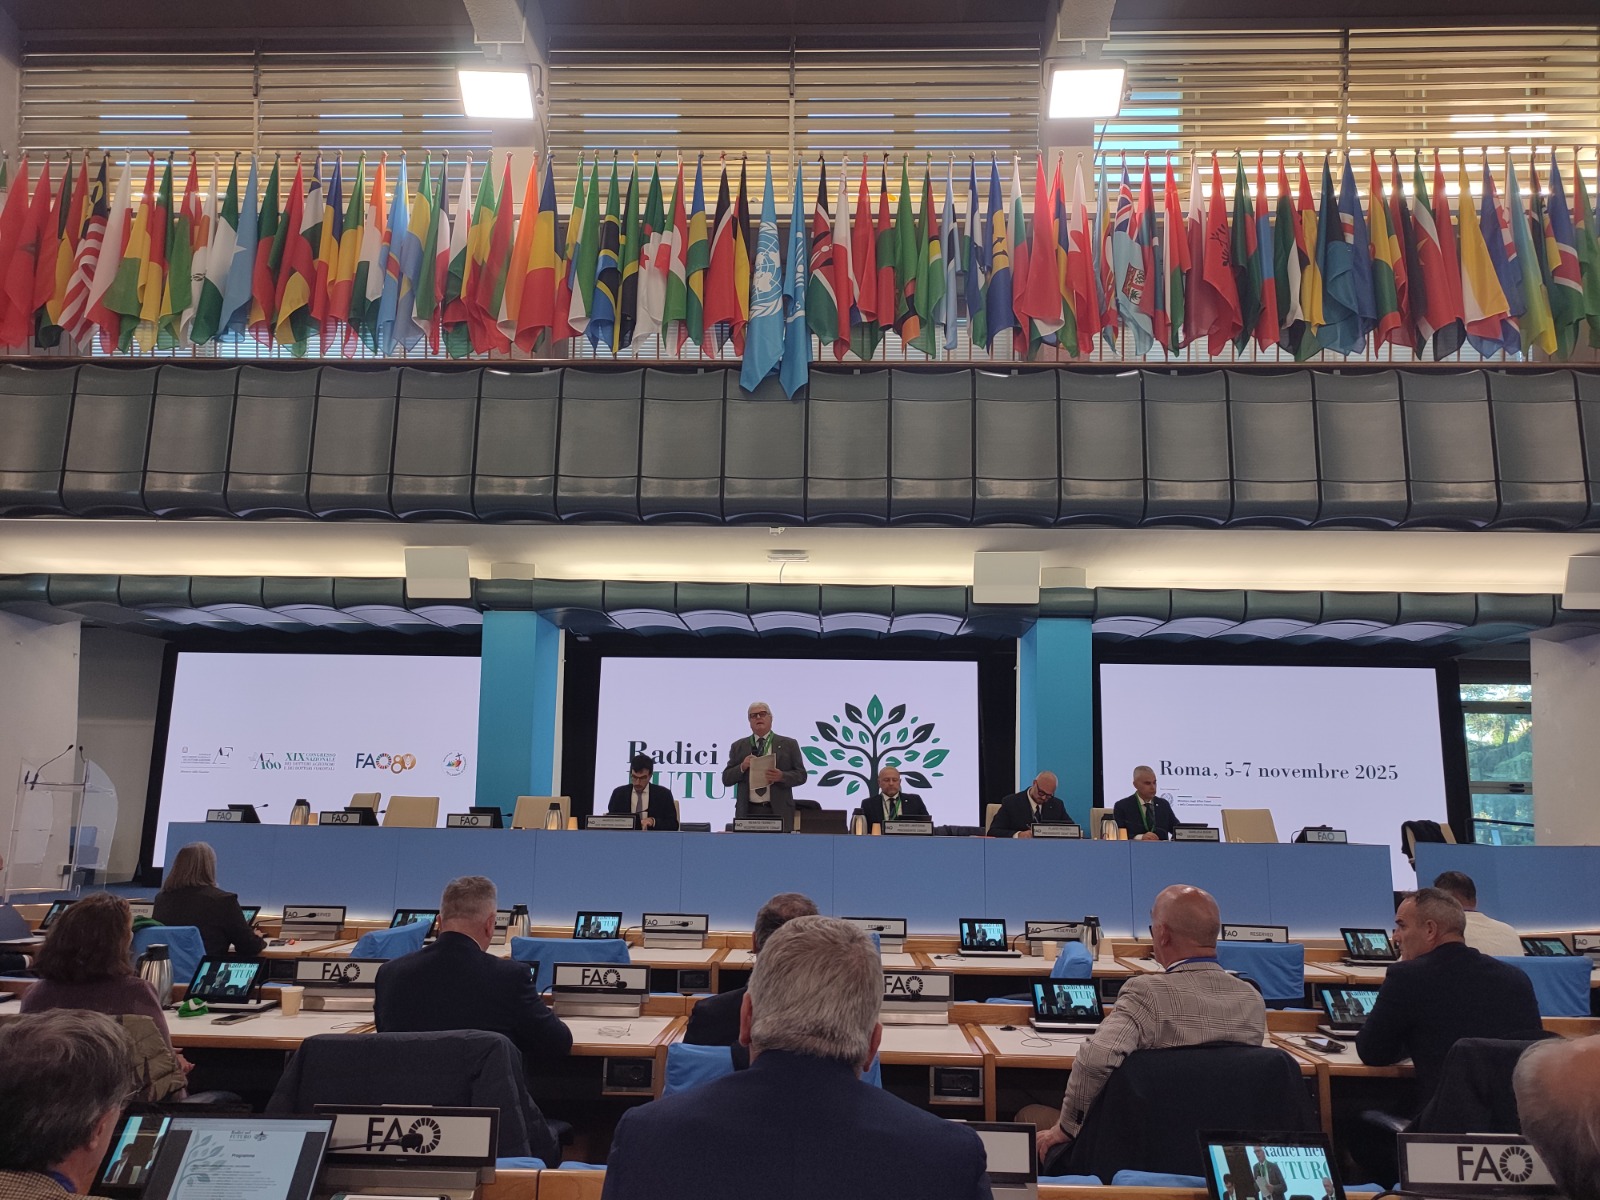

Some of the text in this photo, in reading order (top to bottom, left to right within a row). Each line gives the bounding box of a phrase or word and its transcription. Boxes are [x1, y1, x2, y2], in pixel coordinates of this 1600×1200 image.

[286, 752, 305, 762] XIX
[356, 753, 392, 770] FAO
[626, 741, 718, 765] Radici
[1159, 760, 1399, 780] Roma, 5-7 novembre 2025
[626, 771, 739, 799] UTU
[216, 810, 232, 820] FAO
[331, 813, 349, 823] FAO
[460, 815, 478, 826] FAO
[1318, 832, 1334, 840] FAO
[322, 963, 360, 981] FAO
[582, 968, 620, 986] FAO
[884, 976, 923, 994] FAO
[366, 1117, 441, 1154] FAO
[1457, 1146, 1533, 1183] FAO
